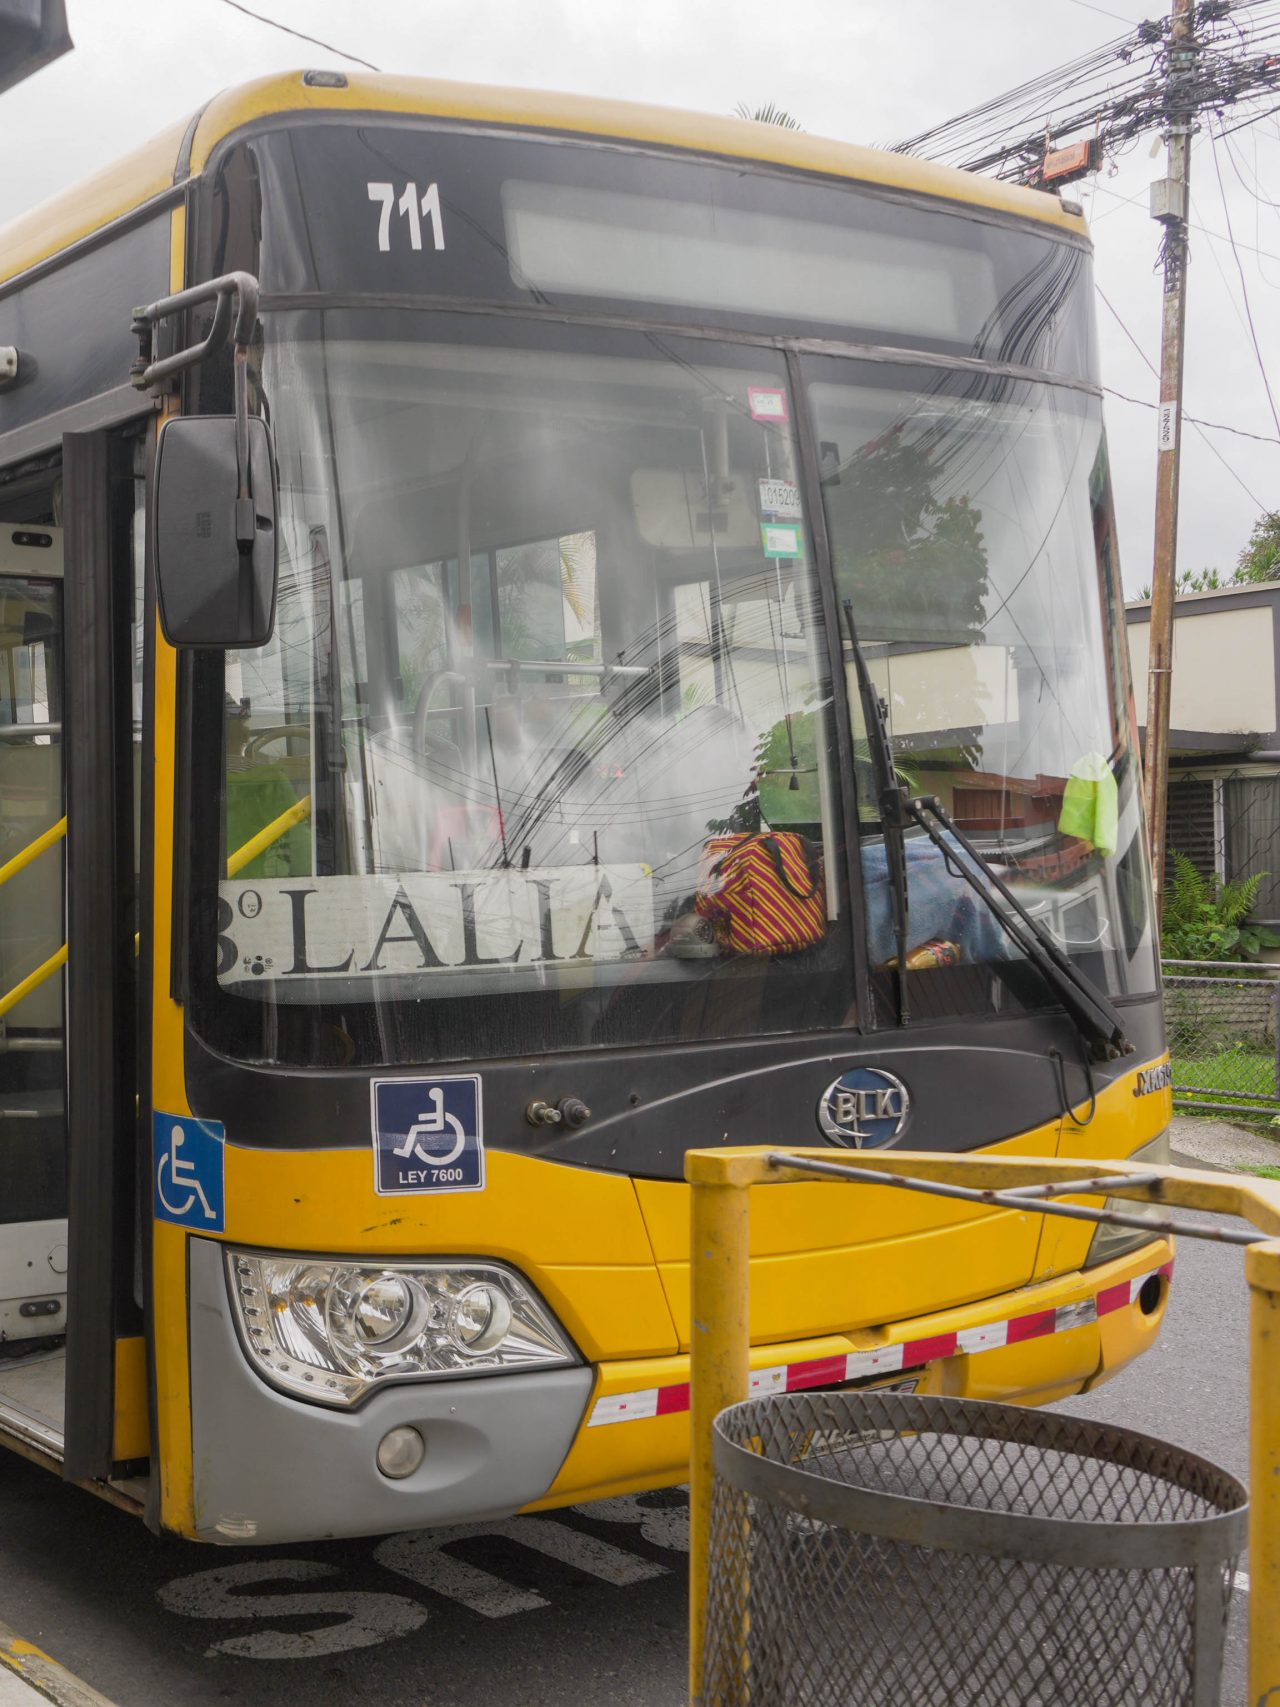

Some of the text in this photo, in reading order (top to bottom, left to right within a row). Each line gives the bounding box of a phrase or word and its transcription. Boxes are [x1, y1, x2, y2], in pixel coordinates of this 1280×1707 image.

[367, 181, 446, 252] 711
[835, 1089, 901, 1124] BLK
[399, 1168, 463, 1184] LEY 7600
